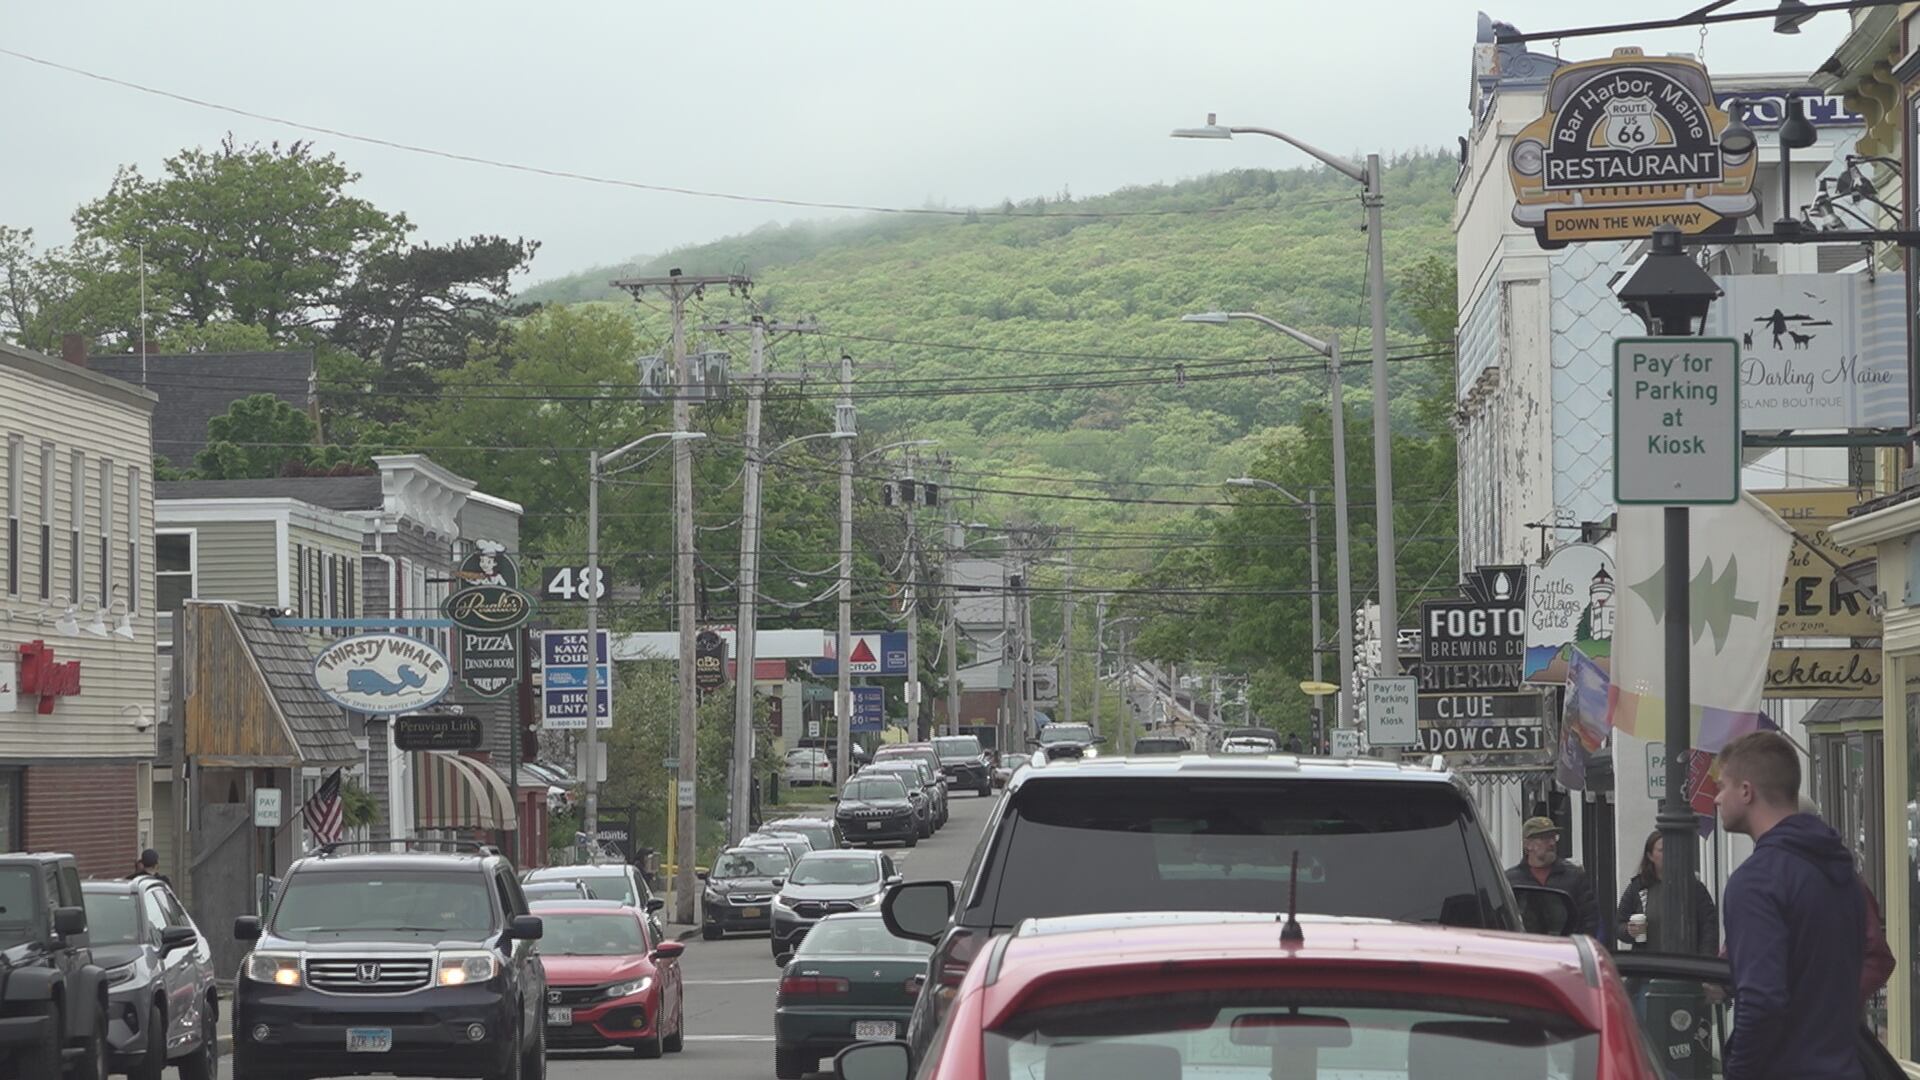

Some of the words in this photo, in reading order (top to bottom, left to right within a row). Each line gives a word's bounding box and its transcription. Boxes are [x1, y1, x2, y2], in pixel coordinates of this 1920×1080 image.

[1558, 109, 1585, 144] Bar
[1580, 76, 1654, 110] Harbor,
[1659, 83, 1704, 140] Maine
[1612, 103, 1648, 114] ROUTE
[1623, 115, 1638, 126] US
[1617, 125, 1645, 144] 66
[1549, 152, 1715, 181] RESTAURANT
[1555, 218, 1600, 232] DOWN
[1603, 216, 1629, 229] THE
[1632, 212, 1702, 228] WALKWAY
[1633, 353, 1674, 377] Pay
[1683, 353, 1713, 373] for
[1740, 356, 1815, 394] Darling
[1820, 354, 1893, 386] Maine
[1635, 380, 1718, 406] Parking
[1740, 398, 1778, 409] SLAND
[1782, 396, 1842, 409] BOUTIQUE
[1662, 408, 1683, 427] at
[1648, 434, 1706, 454] Kiosk
[1779, 506, 1817, 520] THE
[1812, 529, 1858, 559] Street
[547, 566, 606, 600] 48
[1430, 608, 1525, 637] FOGTO
[1532, 609, 1569, 631] Gifts
[465, 633, 514, 652] PIZZA
[563, 635, 588, 644] SEA
[554, 645, 588, 653] KAYA
[1431, 640, 1498, 657] BREWING
[317, 639, 386, 671] THIRSTY
[388, 638, 444, 674] WHALE
[553, 654, 588, 663] TOUR
[465, 658, 493, 670] DINING
[493, 657, 515, 669] ROOM
[849, 663, 877, 671] CITGO
[472, 677, 492, 691] TAKE
[492, 677, 507, 690] OUT
[1373, 684, 1391, 693] Pay
[1394, 683, 1407, 692] for
[1375, 695, 1409, 705] Parking
[1437, 695, 1494, 718] CLUE
[549, 704, 606, 714] RENTAS
[1385, 707, 1395, 715] at
[400, 721, 448, 732] Peruvian
[450, 720, 478, 732] Link
[1379, 717, 1405, 726] Kiosk
[1404, 727, 1543, 751] ADOWCAST
[1651, 755, 1666, 768] PA
[1650, 775, 1665, 787] HE
[259, 798, 277, 806] PAY
[257, 810, 278, 819] HERE
